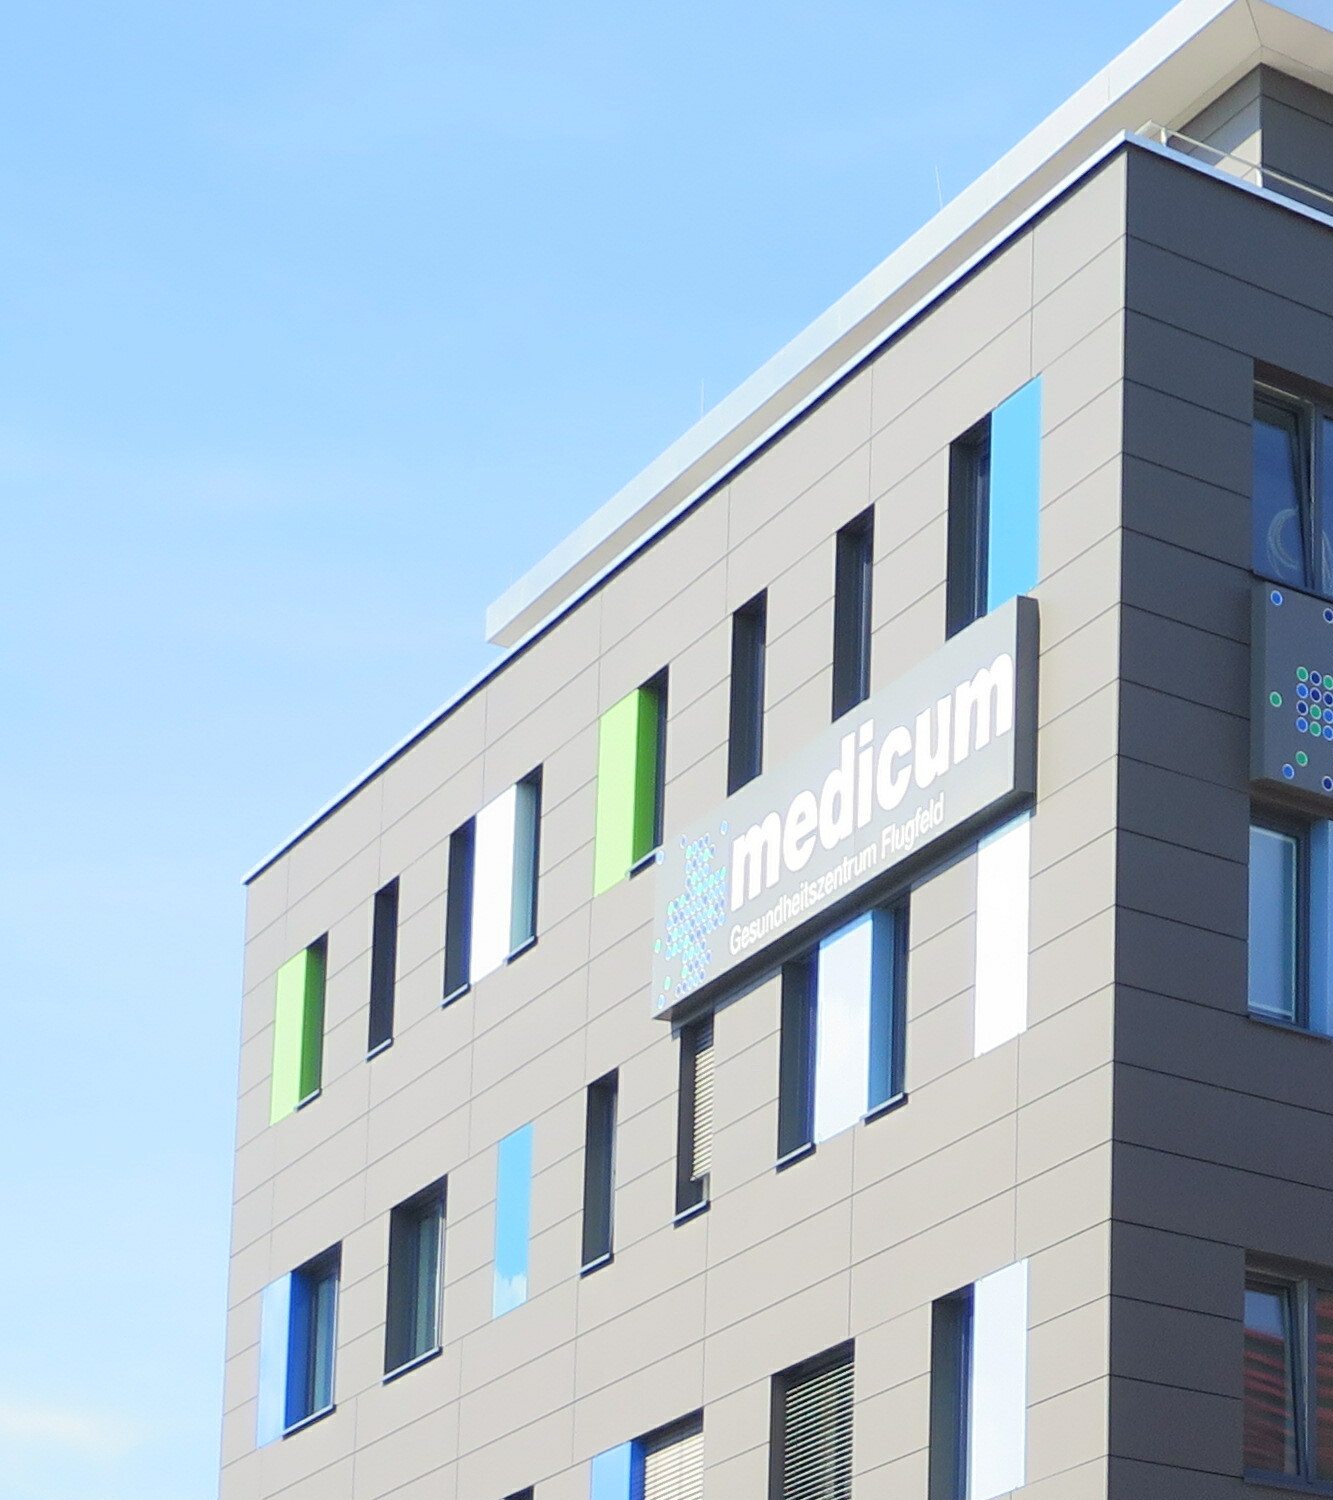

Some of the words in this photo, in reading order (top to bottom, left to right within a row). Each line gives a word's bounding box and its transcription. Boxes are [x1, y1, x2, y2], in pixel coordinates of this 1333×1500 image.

[729, 842, 878, 956] Gesundheitszentrum
[880, 791, 945, 860] Flugfeld
[731, 652, 1014, 912] medicum
